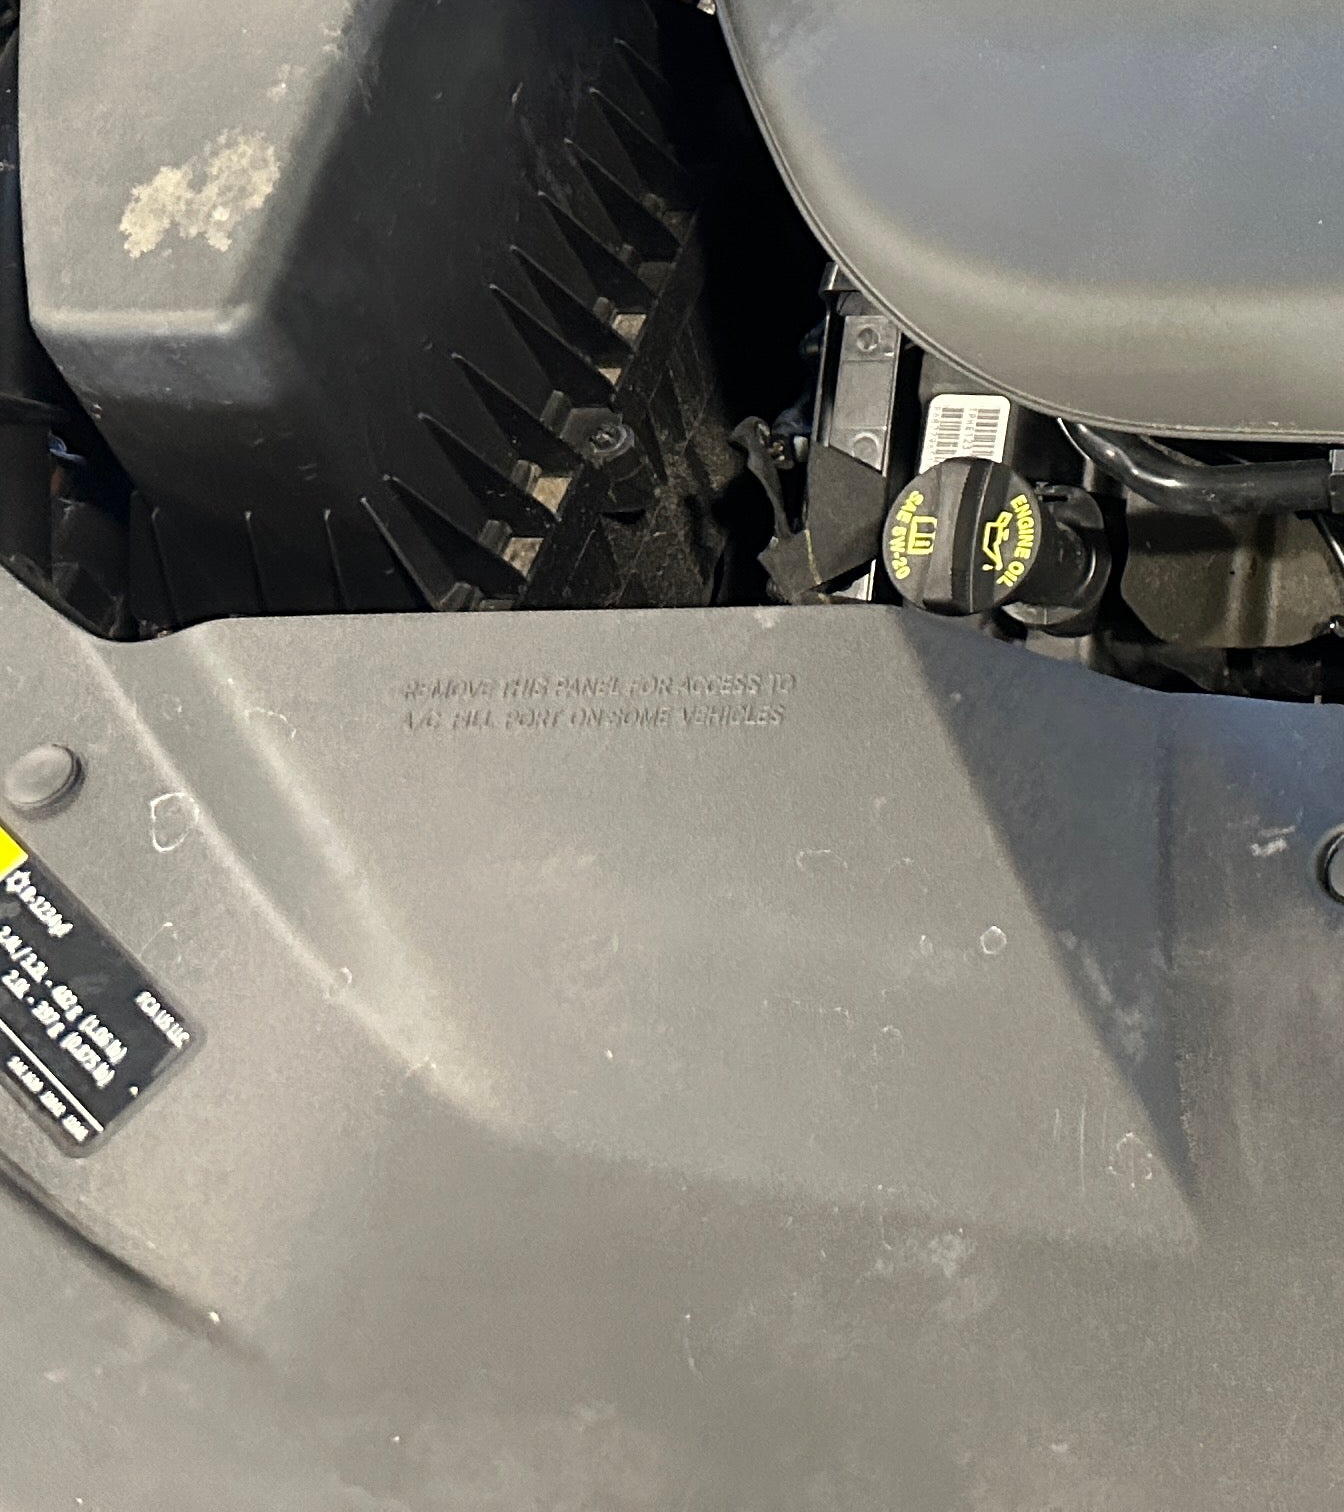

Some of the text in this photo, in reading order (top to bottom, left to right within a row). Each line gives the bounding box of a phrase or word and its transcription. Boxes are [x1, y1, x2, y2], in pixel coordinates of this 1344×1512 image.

[896, 490, 925, 524] SAE
[996, 494, 1036, 588] ENGINE OIL
[404, 672, 799, 700] REMOVE THIS PANEL FOR ACCESS TO
[403, 703, 786, 731] A/C FILL PORT ON SOME VEHICLES
